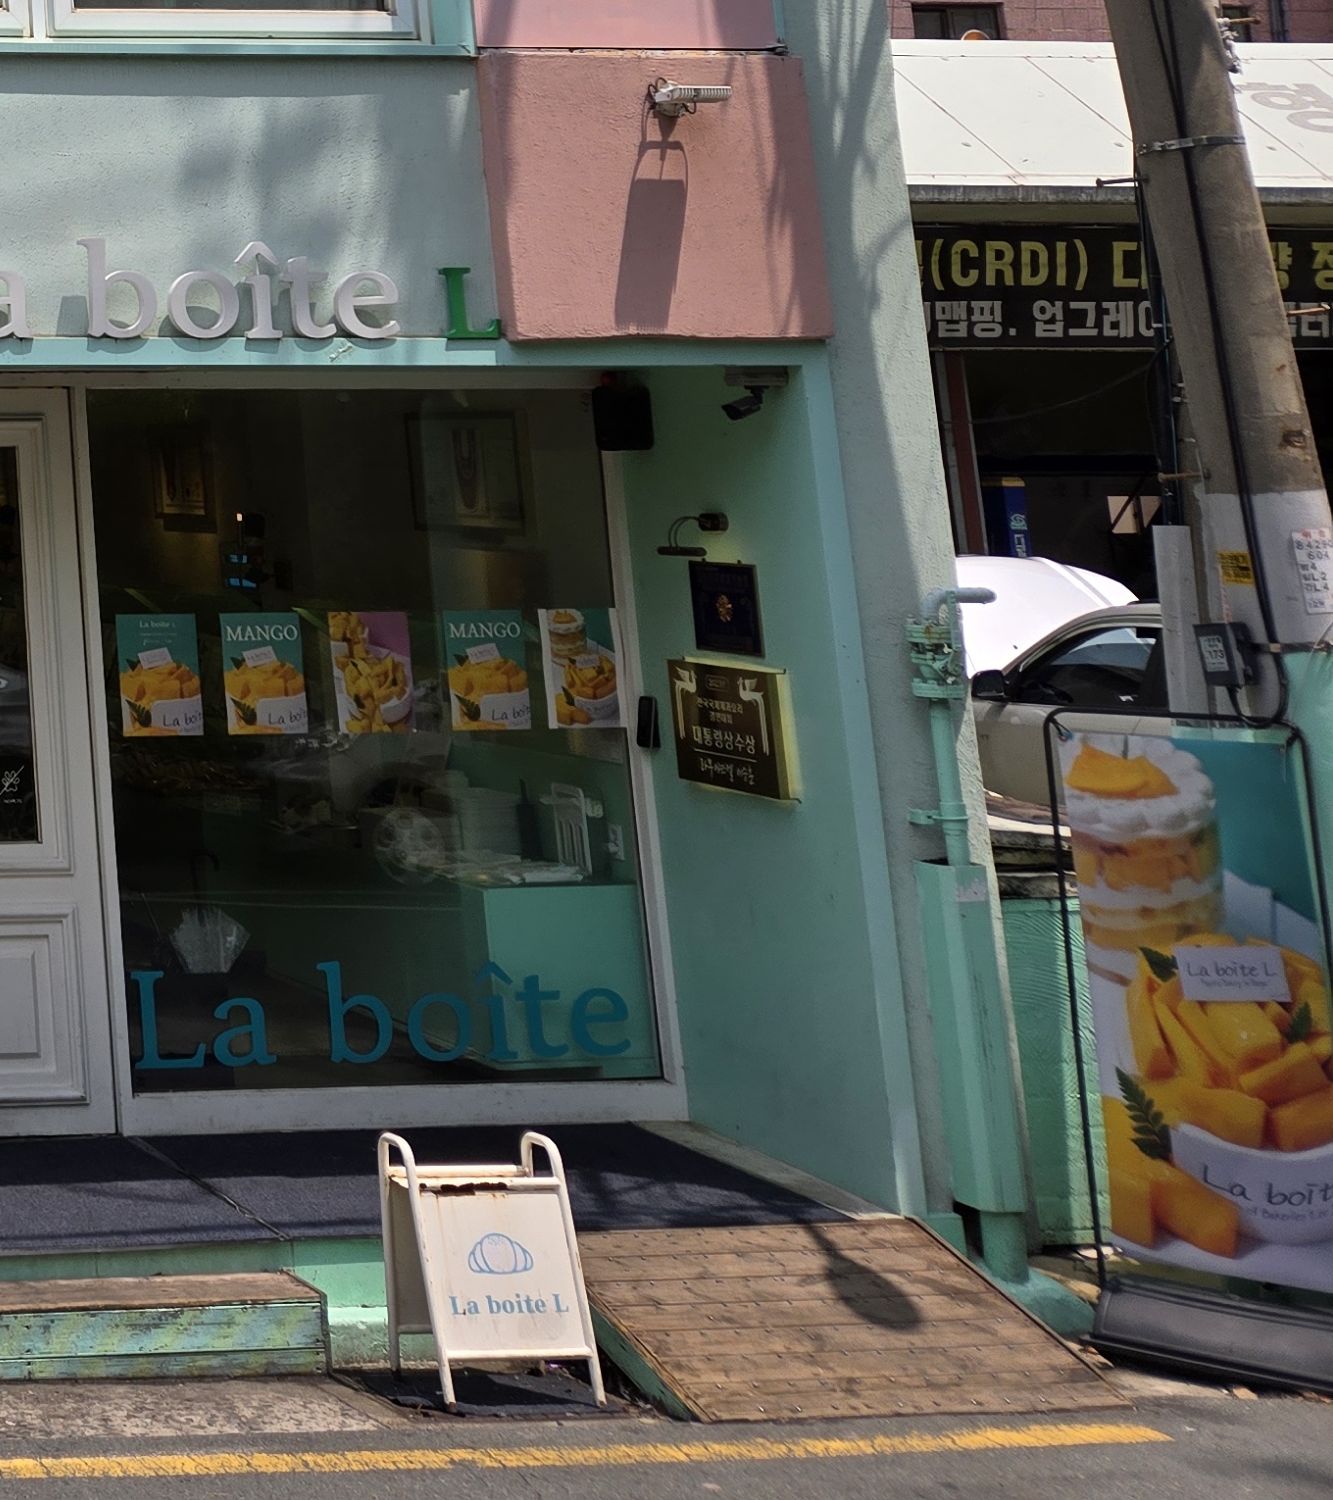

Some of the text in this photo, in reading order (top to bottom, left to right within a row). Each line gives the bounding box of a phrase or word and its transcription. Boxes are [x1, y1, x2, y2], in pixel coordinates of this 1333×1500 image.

[76, 237, 402, 341] boîte
[437, 266, 502, 340] L
[225, 624, 298, 642] MANGO
[448, 621, 521, 639] MANGO
[692, 725, 756, 755] 대통령상수상
[1186, 961, 1210, 978] La
[1263, 961, 1277, 977] L
[129, 959, 632, 1071] La boîte
[1202, 1162, 1253, 1202] La
[449, 1292, 570, 1316] La boite L
